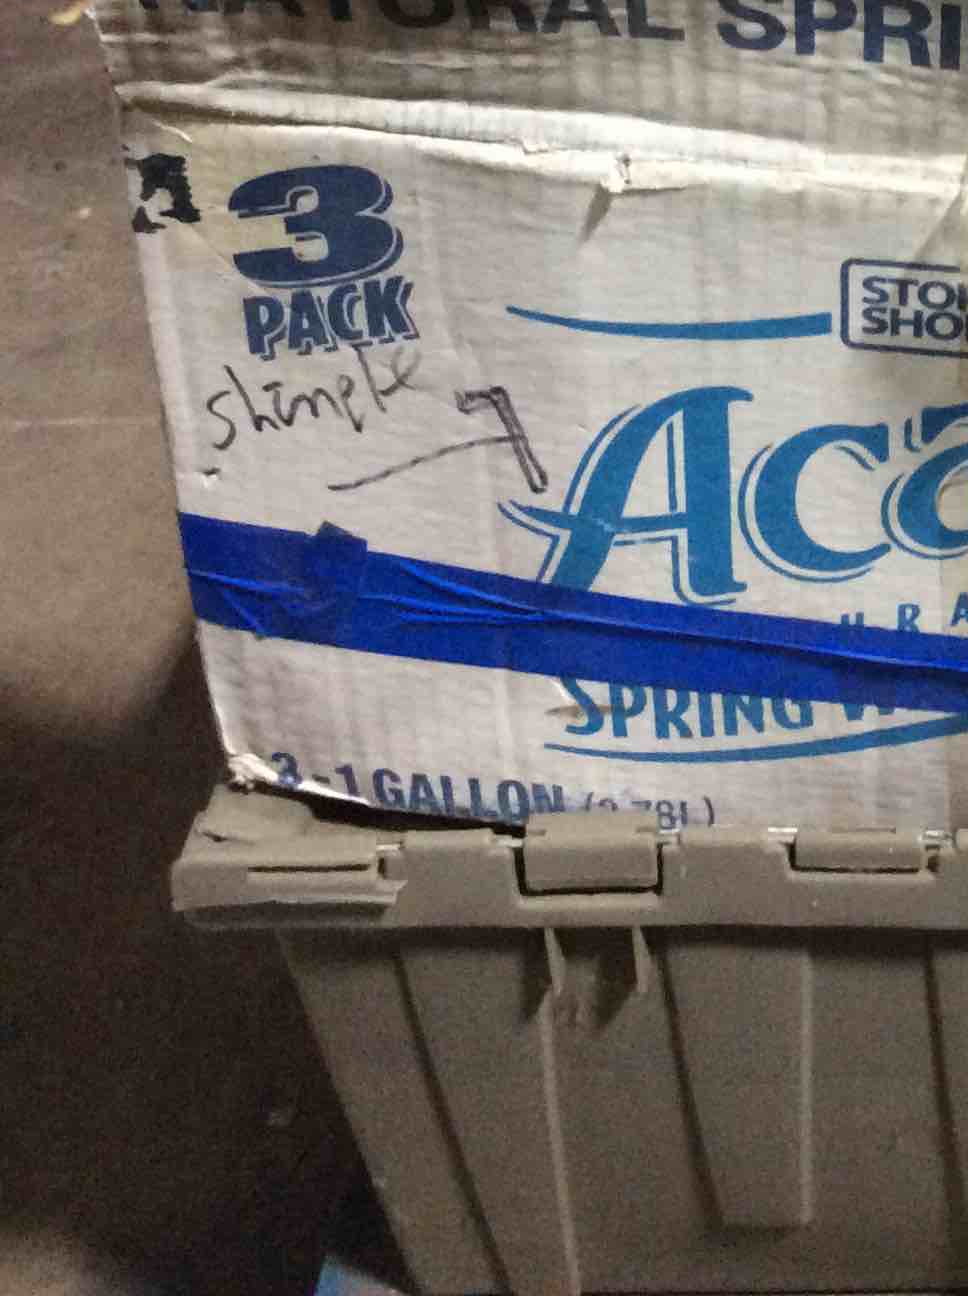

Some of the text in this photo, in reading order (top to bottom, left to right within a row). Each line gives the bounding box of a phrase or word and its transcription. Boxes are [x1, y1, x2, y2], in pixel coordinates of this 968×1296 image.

[228, 164, 405, 289] 3
[243, 276, 421, 361] PACK
[371, 767, 567, 827] GALLON
